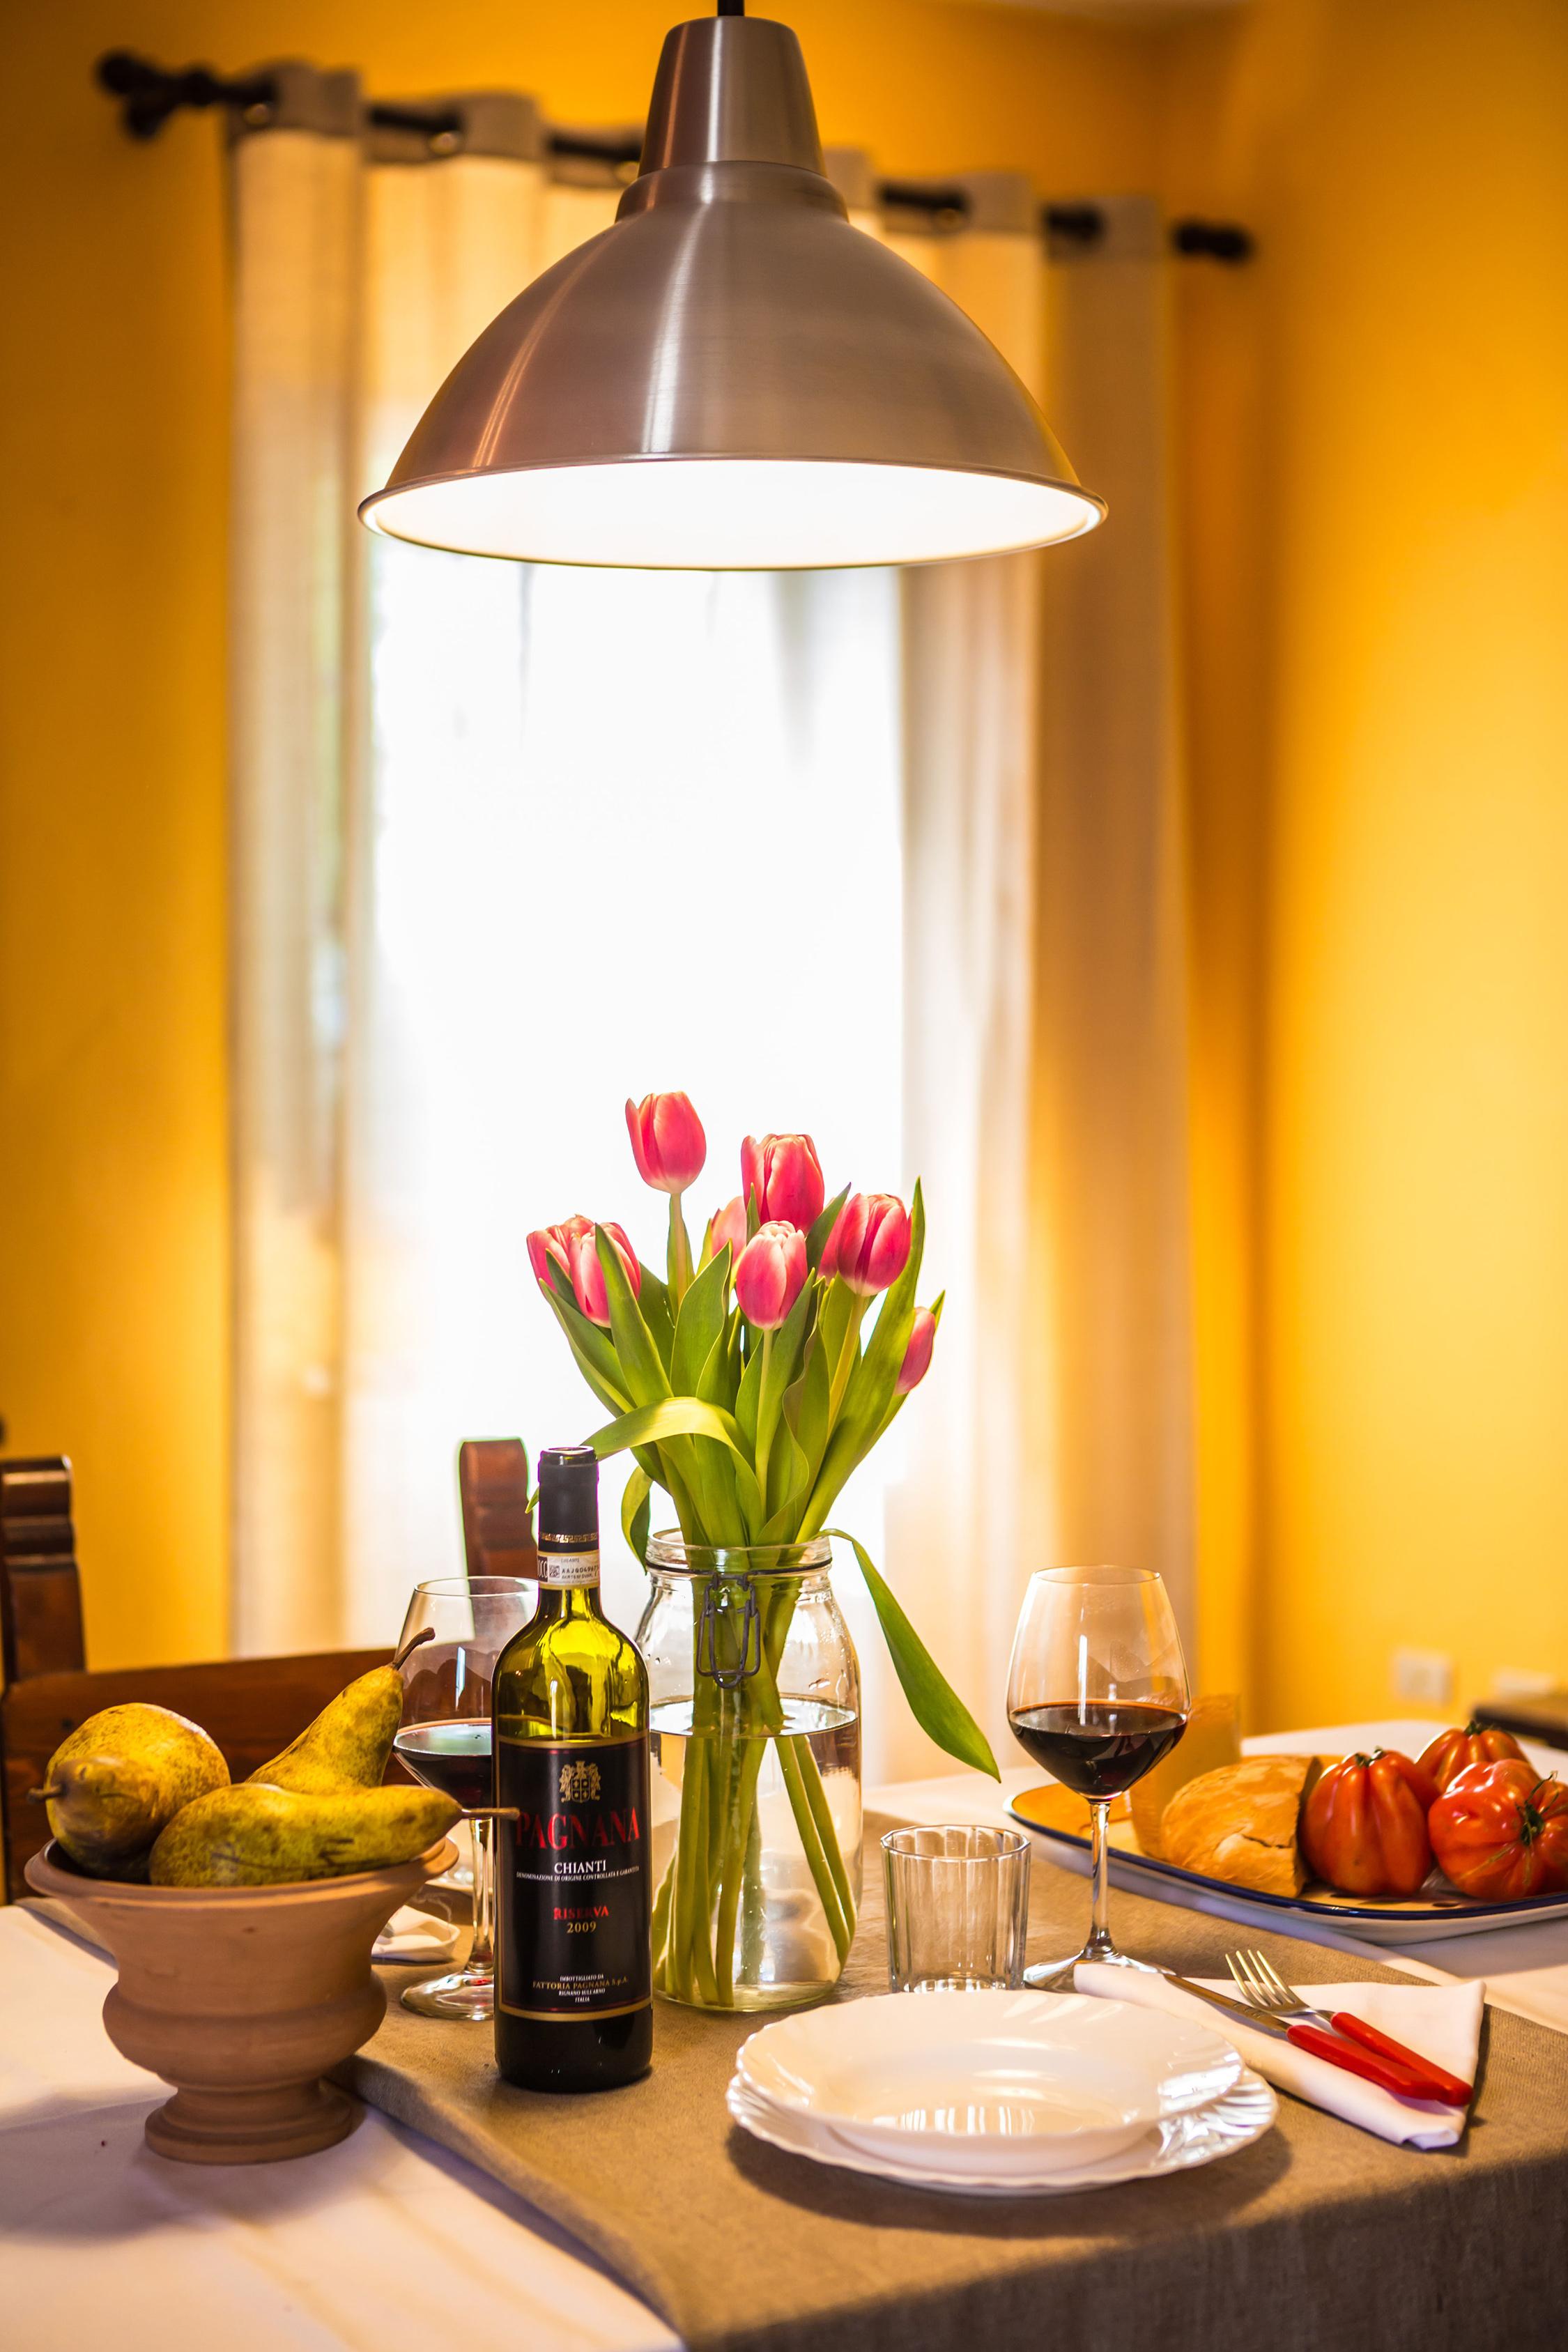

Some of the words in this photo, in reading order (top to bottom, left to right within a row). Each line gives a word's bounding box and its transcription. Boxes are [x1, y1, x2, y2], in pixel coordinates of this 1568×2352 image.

[516, 1806, 640, 1850] PAGNANA
[554, 1859, 606, 1874] CHIANTI
[567, 1921, 597, 1934] 2009
[532, 1981, 570, 1990] FATTORIA
[573, 1981, 610, 1989] PAGNANA
